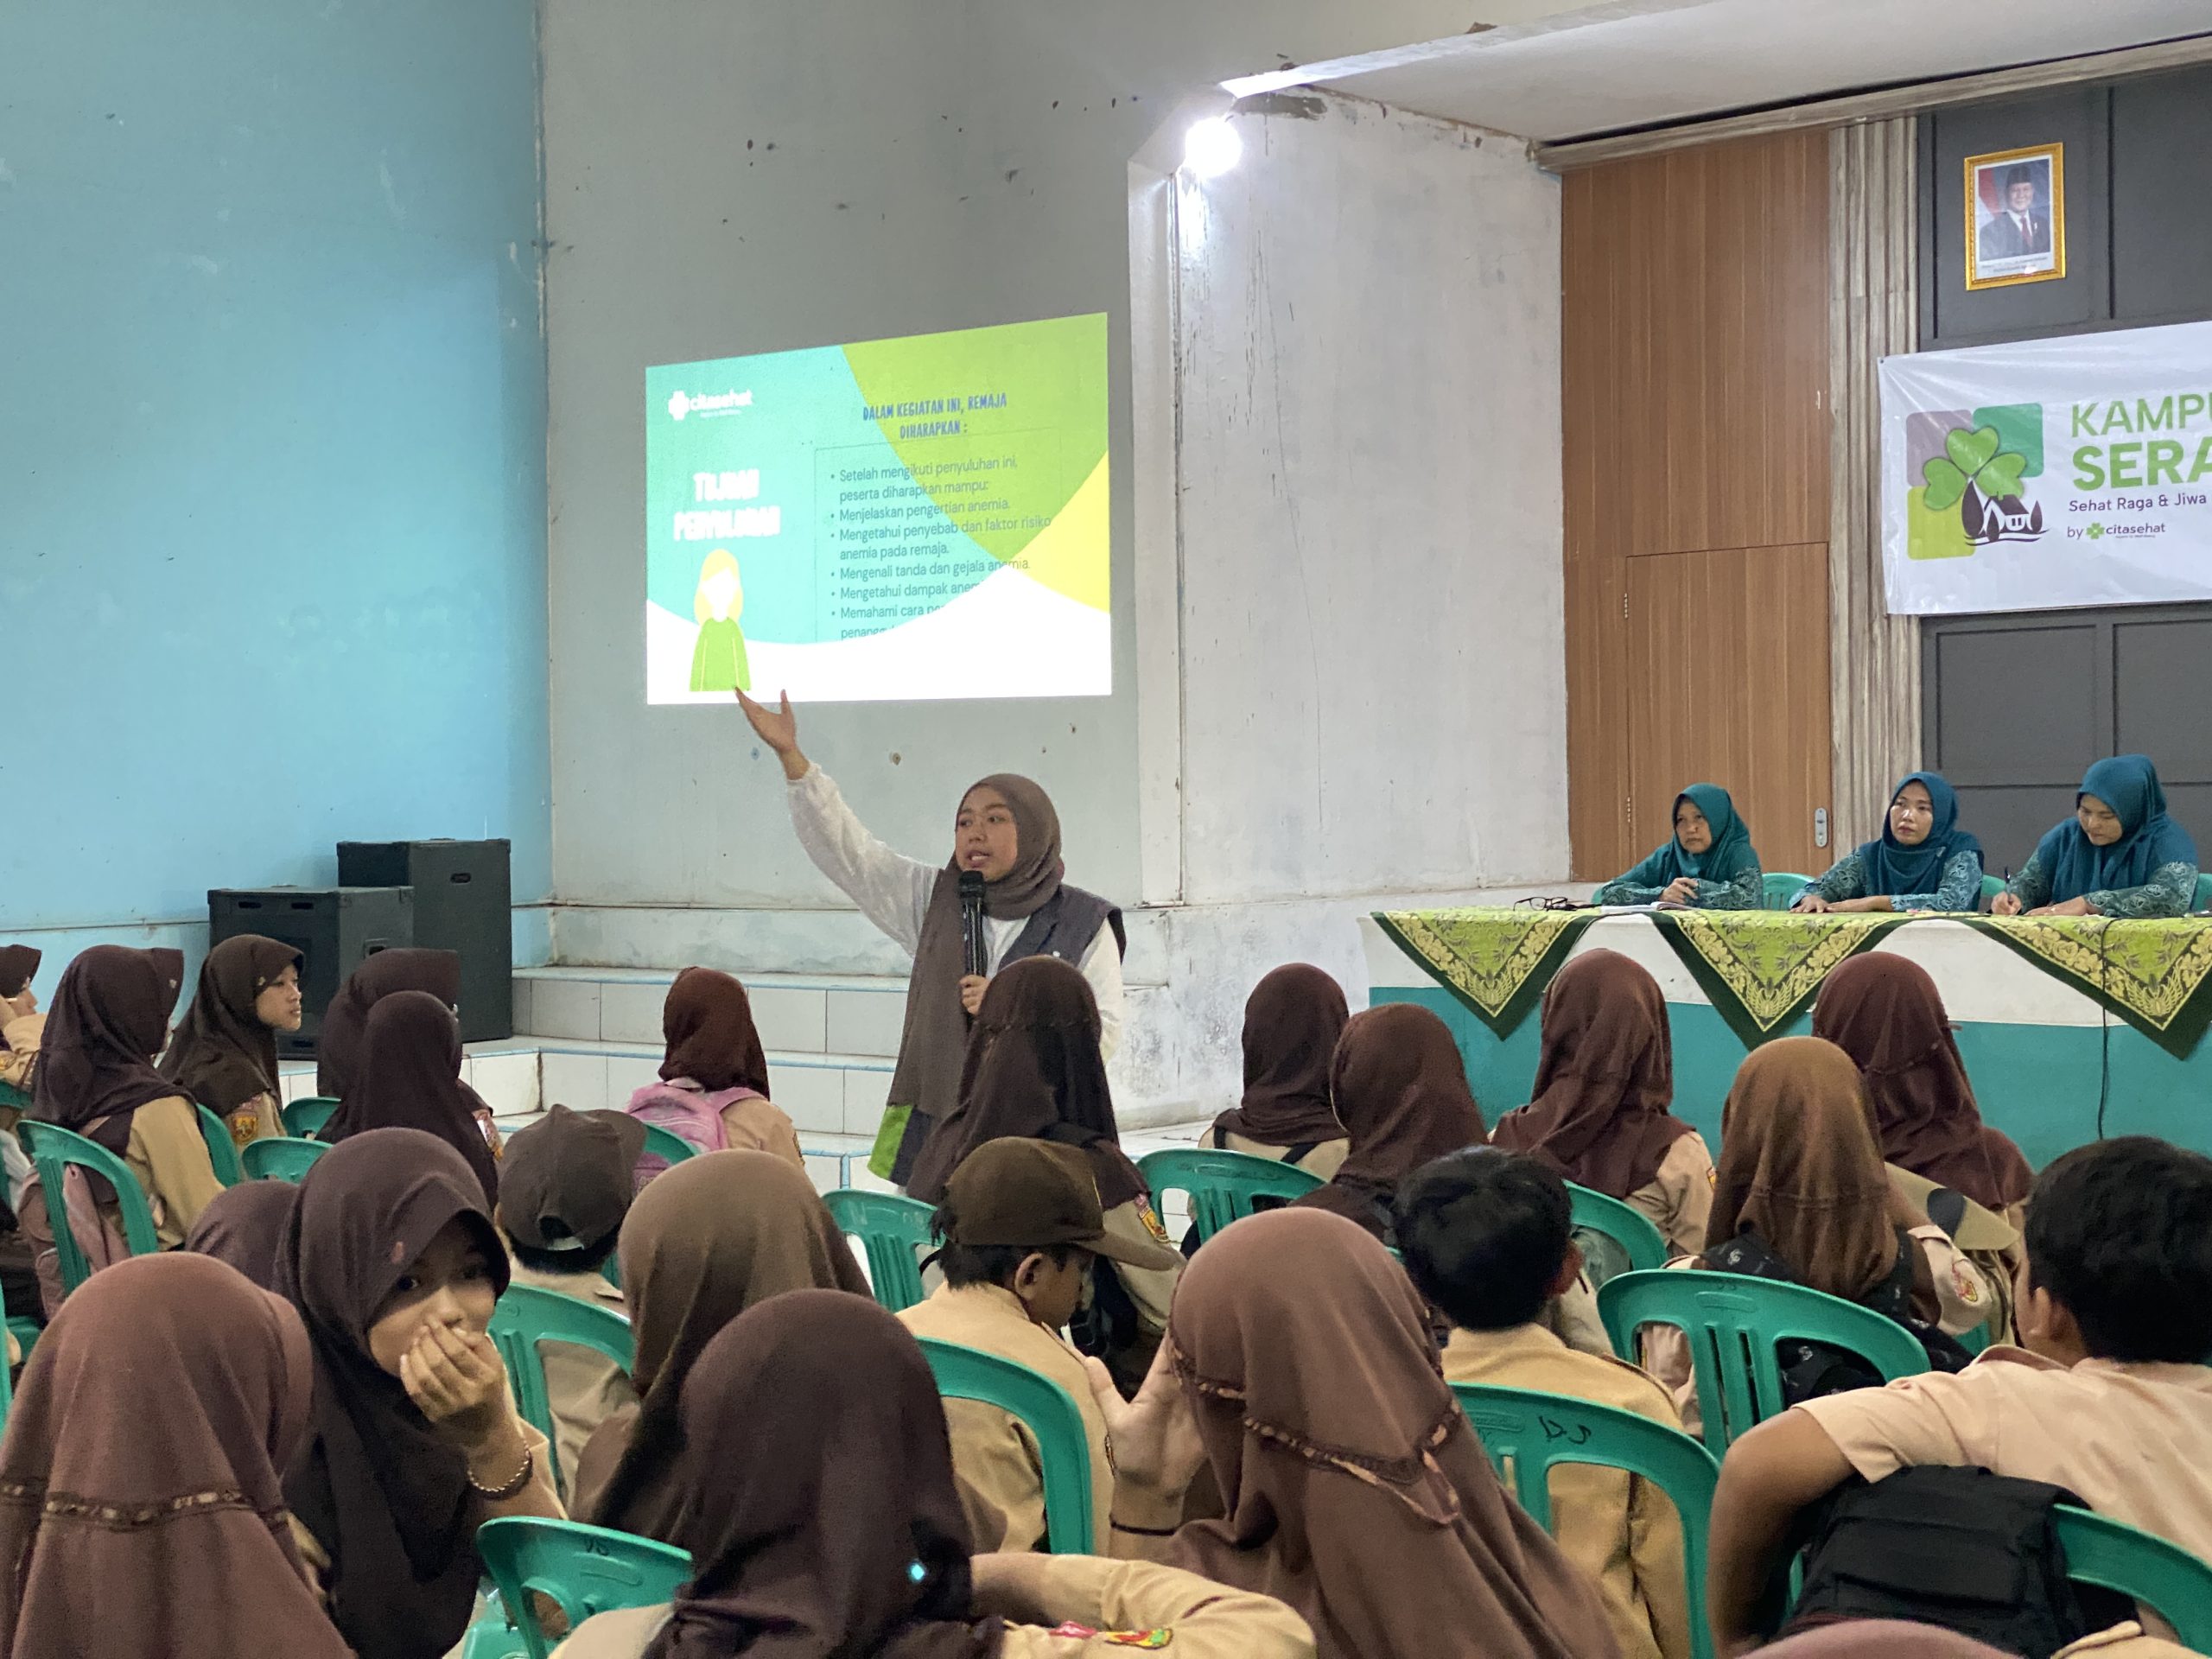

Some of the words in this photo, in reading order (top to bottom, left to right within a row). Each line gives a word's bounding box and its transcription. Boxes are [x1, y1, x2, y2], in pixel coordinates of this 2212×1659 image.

[863, 404, 894, 422] DALAM
[897, 399, 944, 417] KEGIATAN
[947, 397, 963, 415] INI,
[968, 392, 1007, 410] REMAJA
[2071, 391, 2212, 438] KAMP
[899, 420, 960, 439] DIHARAPKAN
[840, 467, 878, 482] Setelah
[880, 462, 933, 481] mengikuti
[936, 457, 1000, 477] penyuluhan
[840, 489, 880, 505] peserta
[882, 484, 942, 499] diharapkan
[944, 480, 989, 495] mampu:
[2069, 499, 2112, 512] Sehat
[2117, 497, 2153, 512] Raga
[2158, 494, 2169, 507] &
[2174, 493, 2207, 506] Jiwa
[840, 506, 904, 524] Menjelaskan
[906, 501, 965, 520] pengertian
[840, 524, 901, 543] Mengetahui
[903, 521, 958, 541] penyebab
[961, 519, 982, 533] dan
[985, 518, 1018, 531] faktor
[1021, 514, 1052, 529] risiko
[2067, 526, 2083, 540] by
[2106, 523, 2165, 535] citasehat
[840, 546, 878, 560] anemia
[880, 544, 907, 562] pada
[910, 540, 949, 558] remaja.
[840, 564, 893, 582] Mengenali
[895, 563, 926, 577] tanda
[929, 562, 950, 575] dan
[953, 559, 985, 577] gejala
[840, 584, 901, 601] Mengetahui
[904, 582, 948, 598] dampak
[841, 604, 898, 619] Memahami
[900, 607, 924, 616] cara
